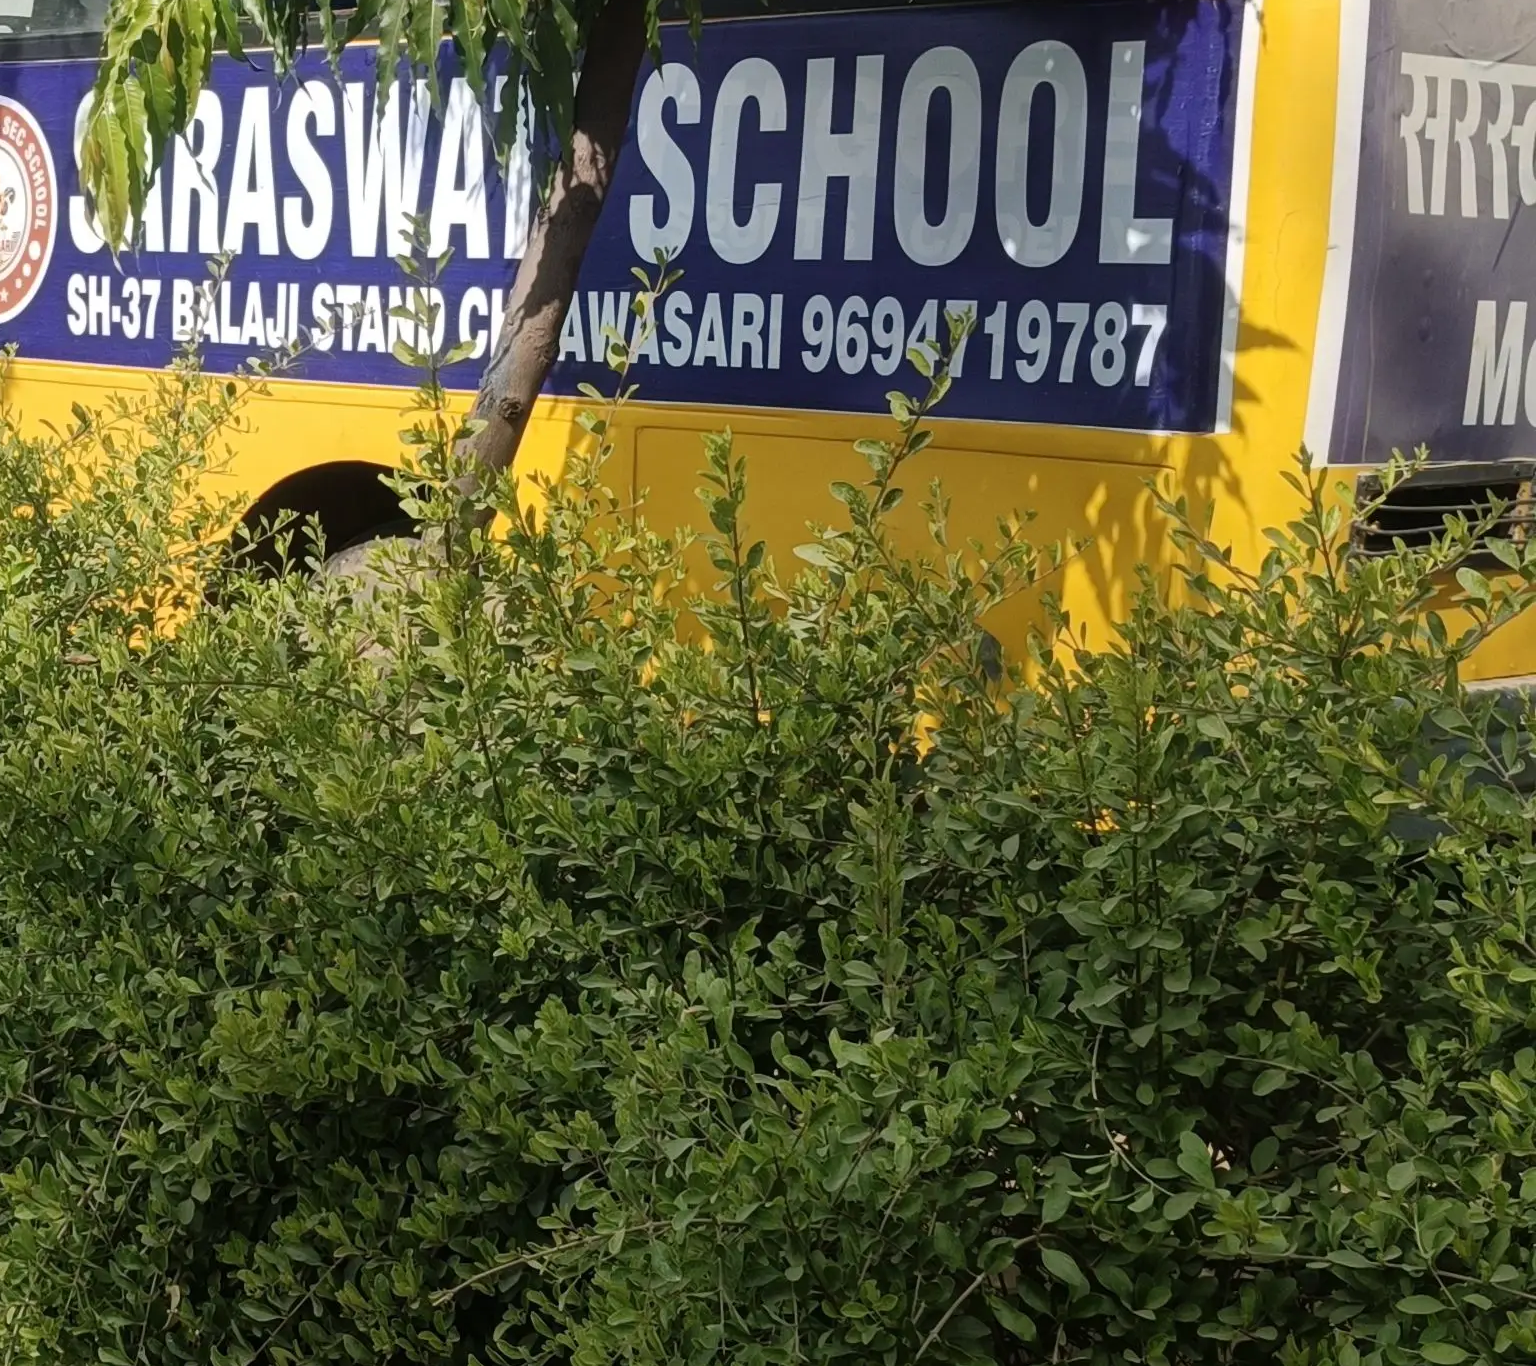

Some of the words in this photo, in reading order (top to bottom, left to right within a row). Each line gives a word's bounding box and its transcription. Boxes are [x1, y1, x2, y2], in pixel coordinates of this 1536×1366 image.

[2, 115, 27, 148] SEC
[23, 142, 49, 230] SCHOOL
[628, 40, 1174, 267] SCHOOL
[66, 273, 161, 340] SH-37
[172, 278, 300, 349] BALAJI
[311, 282, 446, 357] STAND
[801, 294, 1169, 387] 9694719787
